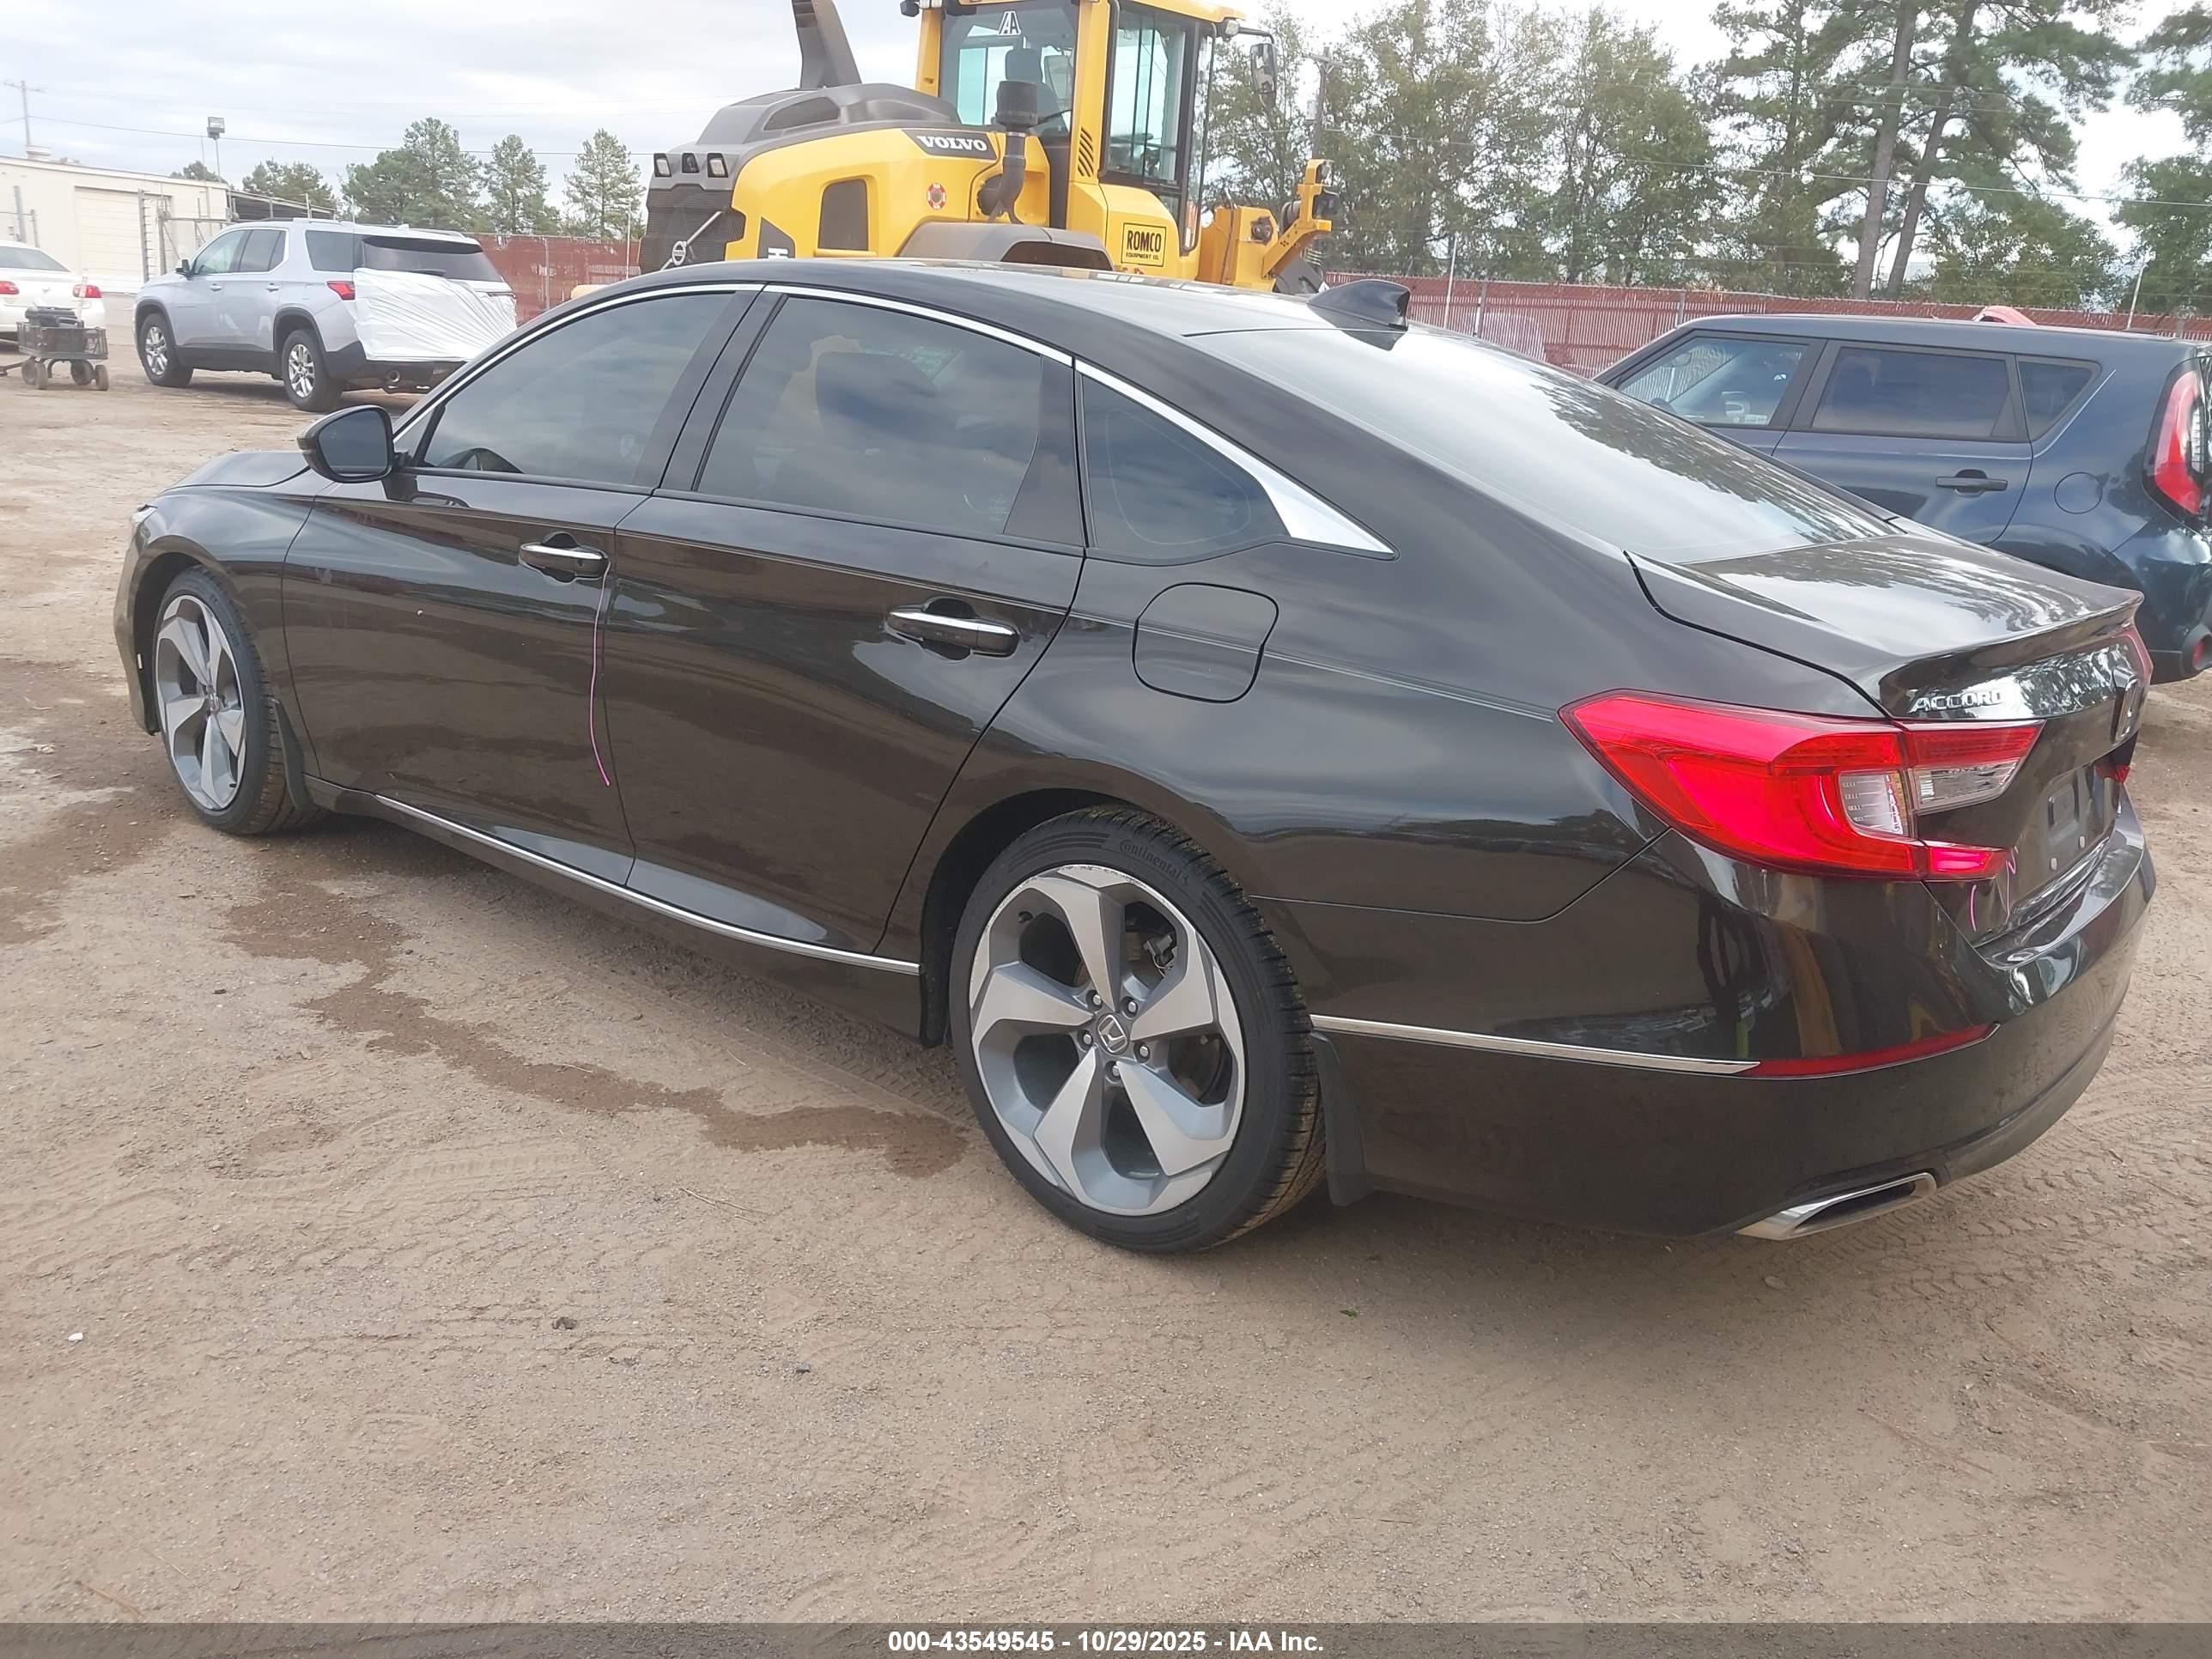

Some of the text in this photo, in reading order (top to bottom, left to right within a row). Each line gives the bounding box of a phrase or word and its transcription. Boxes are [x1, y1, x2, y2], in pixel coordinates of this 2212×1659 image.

[916, 136, 988, 151] VOLVO
[1127, 230, 1162, 252] ROMCO
[1908, 690, 2006, 714] ACCORD
[1119, 839, 1182, 879] Continental
